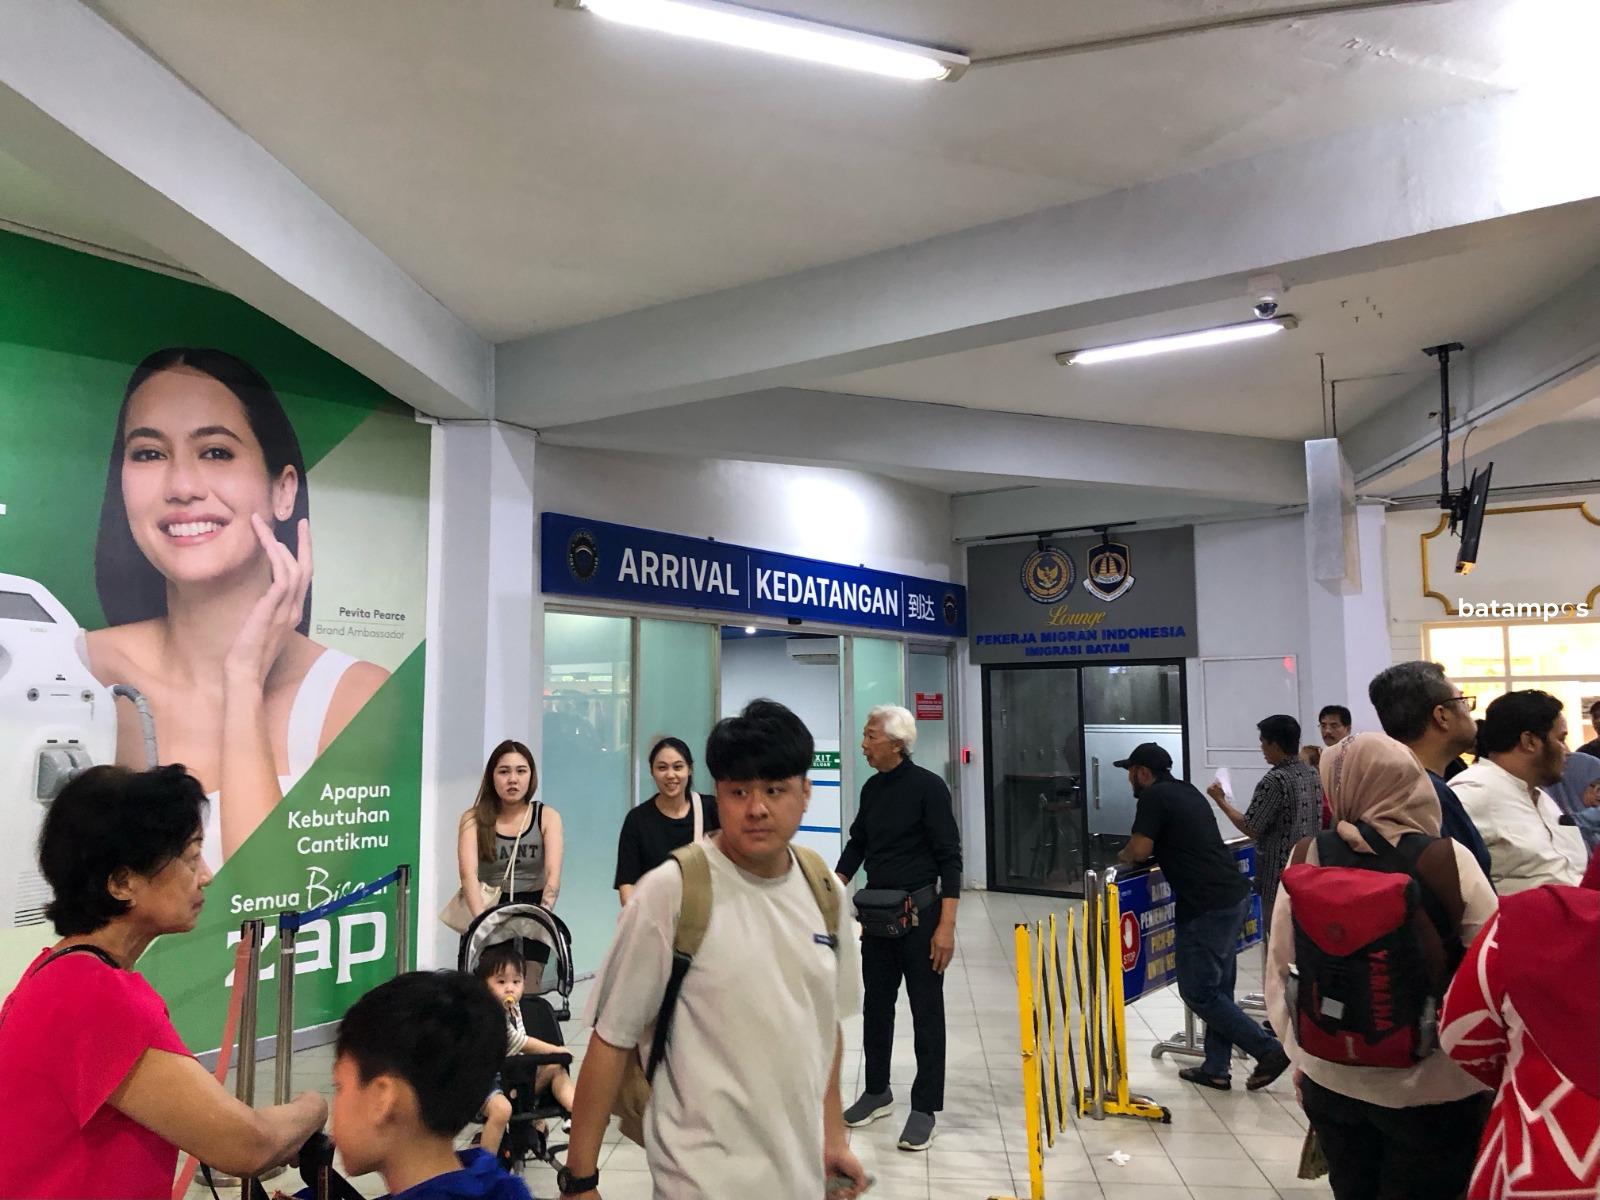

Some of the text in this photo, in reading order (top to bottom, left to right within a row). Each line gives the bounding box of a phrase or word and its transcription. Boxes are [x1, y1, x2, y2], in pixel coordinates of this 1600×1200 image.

[618, 547, 740, 596] ARRIVAL
[756, 568, 899, 617] KEDATANGAN
[339, 606, 406, 621] Pevita Pearce
[908, 593, 936, 621] 到达
[1048, 604, 1107, 631] Lounge
[316, 624, 405, 640] Brand Ambassador
[976, 626, 1186, 646] PEKERJA MIGRAN INDONESIA
[1025, 642, 1130, 656] IMIGRASI BATAM
[815, 754, 831, 762] XIT
[320, 783, 391, 805] Apapun
[288, 807, 389, 829] Kebutuhan
[297, 832, 389, 855] Cantikmu
[230, 893, 300, 914] Semua
[225, 911, 387, 984] zap
[1123, 951, 1136, 965] STOP
